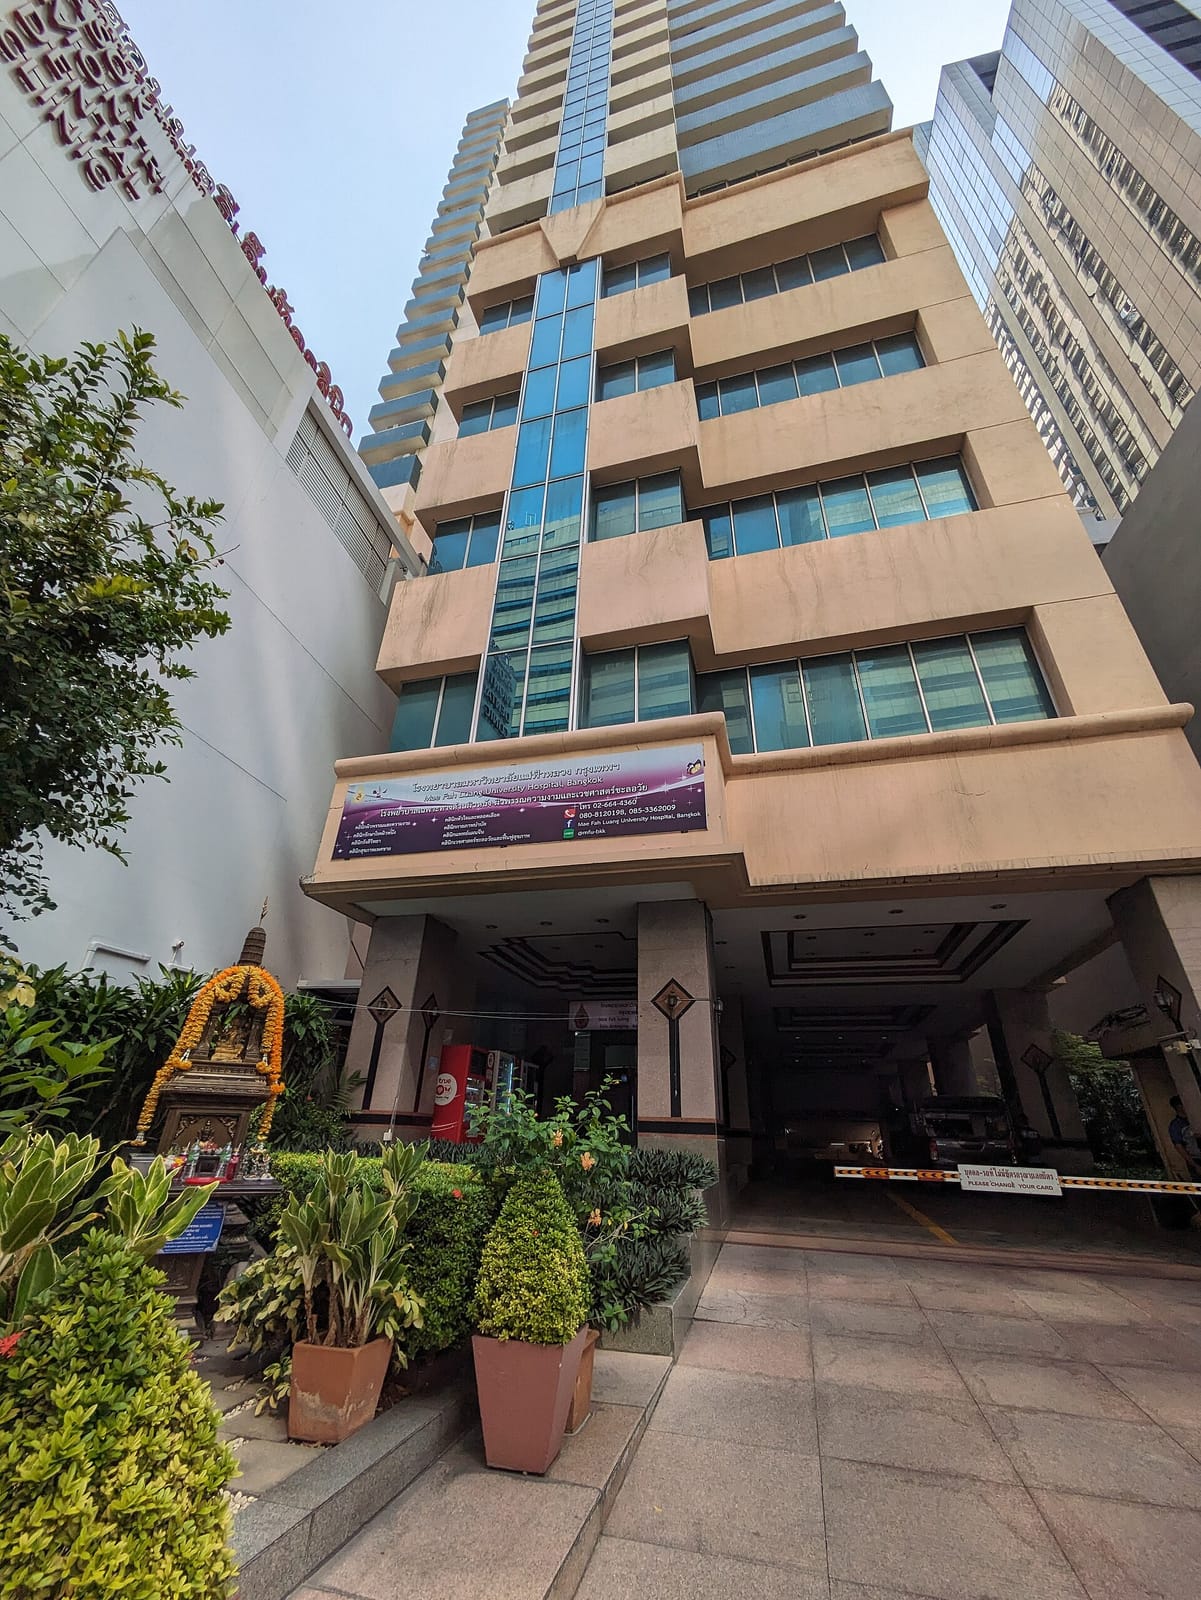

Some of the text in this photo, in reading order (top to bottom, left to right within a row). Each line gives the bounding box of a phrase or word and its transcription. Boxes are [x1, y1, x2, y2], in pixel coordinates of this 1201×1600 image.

[13, 2, 141, 200] DENTAL
[0, 28, 113, 191] CLINIC
[486, 781, 525, 795] University
[567, 776, 604, 787] Bangkok
[592, 799, 638, 809] 02-664-4360
[628, 804, 676, 815] 085-3362009
[620, 815, 649, 824] University
